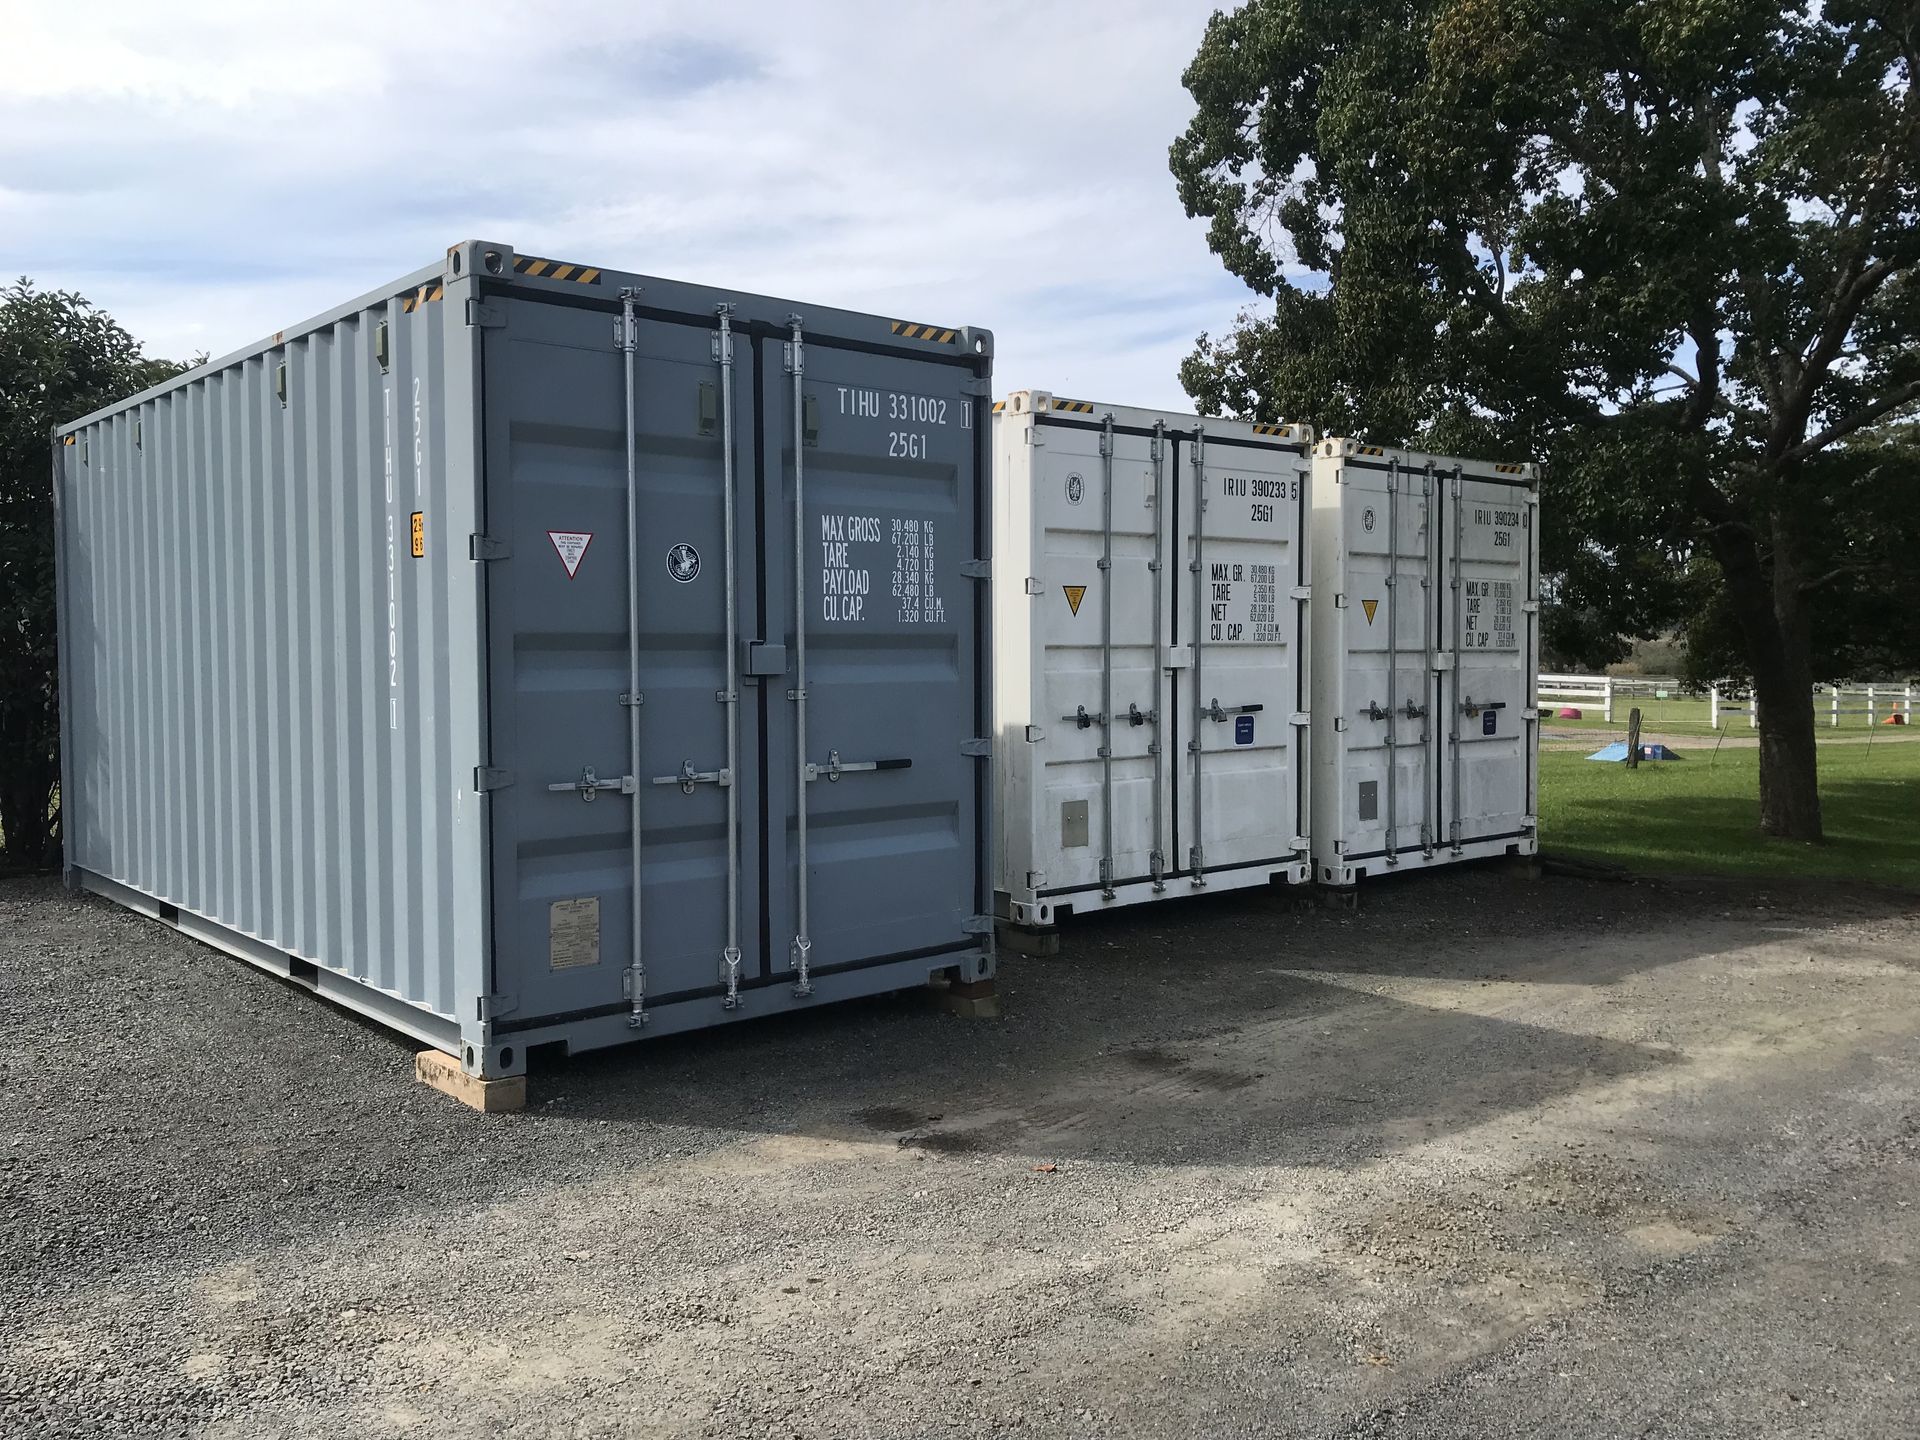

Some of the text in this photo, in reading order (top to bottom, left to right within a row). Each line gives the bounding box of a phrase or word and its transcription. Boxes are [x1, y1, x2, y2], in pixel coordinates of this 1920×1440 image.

[837, 387, 879, 418] TIHU
[889, 393, 947, 425] 331002
[384, 388, 393, 503] TIHU
[889, 431, 926, 459] 25G1
[1224, 478, 1298, 500] IRIU 390233 5
[1251, 504, 1273, 522] 25G1
[1474, 509, 1491, 525] IRIU
[821, 514, 934, 543] MAX GROSS 30.480 KG
[891, 532, 934, 546] 67.200 LB
[822, 542, 934, 568] TARE 2.140 KG
[897, 558, 934, 572] 4.720 LB
[1268, 566, 1275, 574] KG
[823, 569, 934, 595] PAYLOAD 28.340 KG
[1268, 575, 1275, 583] LB
[892, 584, 934, 597] 62.480 LB
[1212, 583, 1231, 601] TARE
[1268, 594, 1275, 603] LB
[388, 515, 397, 686] 331002
[902, 597, 919, 610] 37.4
[1211, 603, 1227, 621] NET
[1268, 613, 1274, 622] LB
